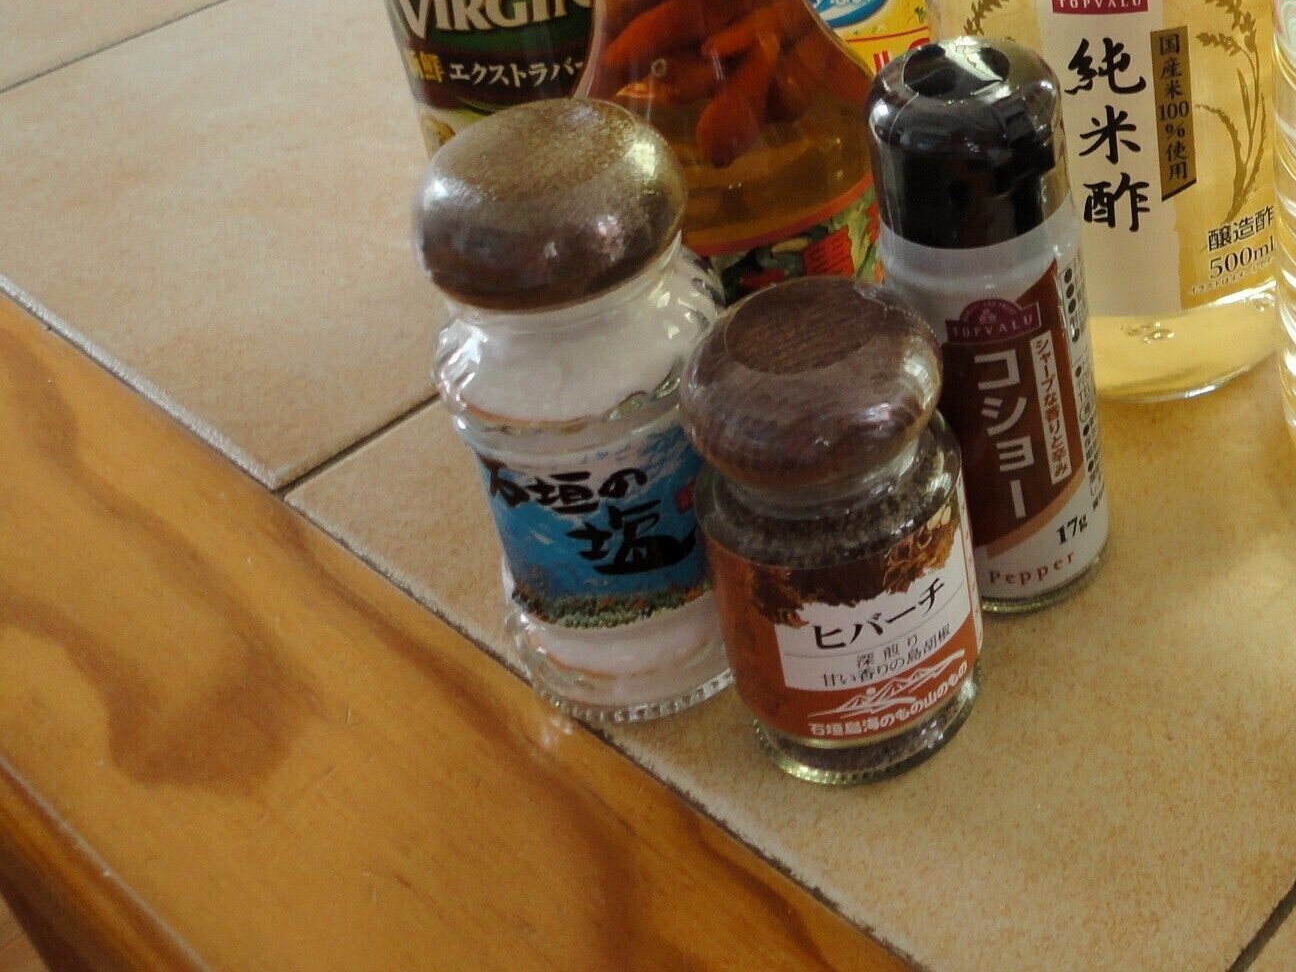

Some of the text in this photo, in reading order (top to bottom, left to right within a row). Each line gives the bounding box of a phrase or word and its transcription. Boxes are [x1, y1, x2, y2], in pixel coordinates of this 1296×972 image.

[1064, 37, 1151, 232] 純米酢
[1158, 32, 1190, 180] 国産米100%使用
[1209, 235, 1275, 279] 500ml
[951, 312, 1034, 338] TOPVALU
[974, 348, 1035, 519] コショー
[1055, 513, 1088, 546] 17g
[988, 550, 1075, 586] Pepper
[812, 577, 945, 651] ヒバーチ
